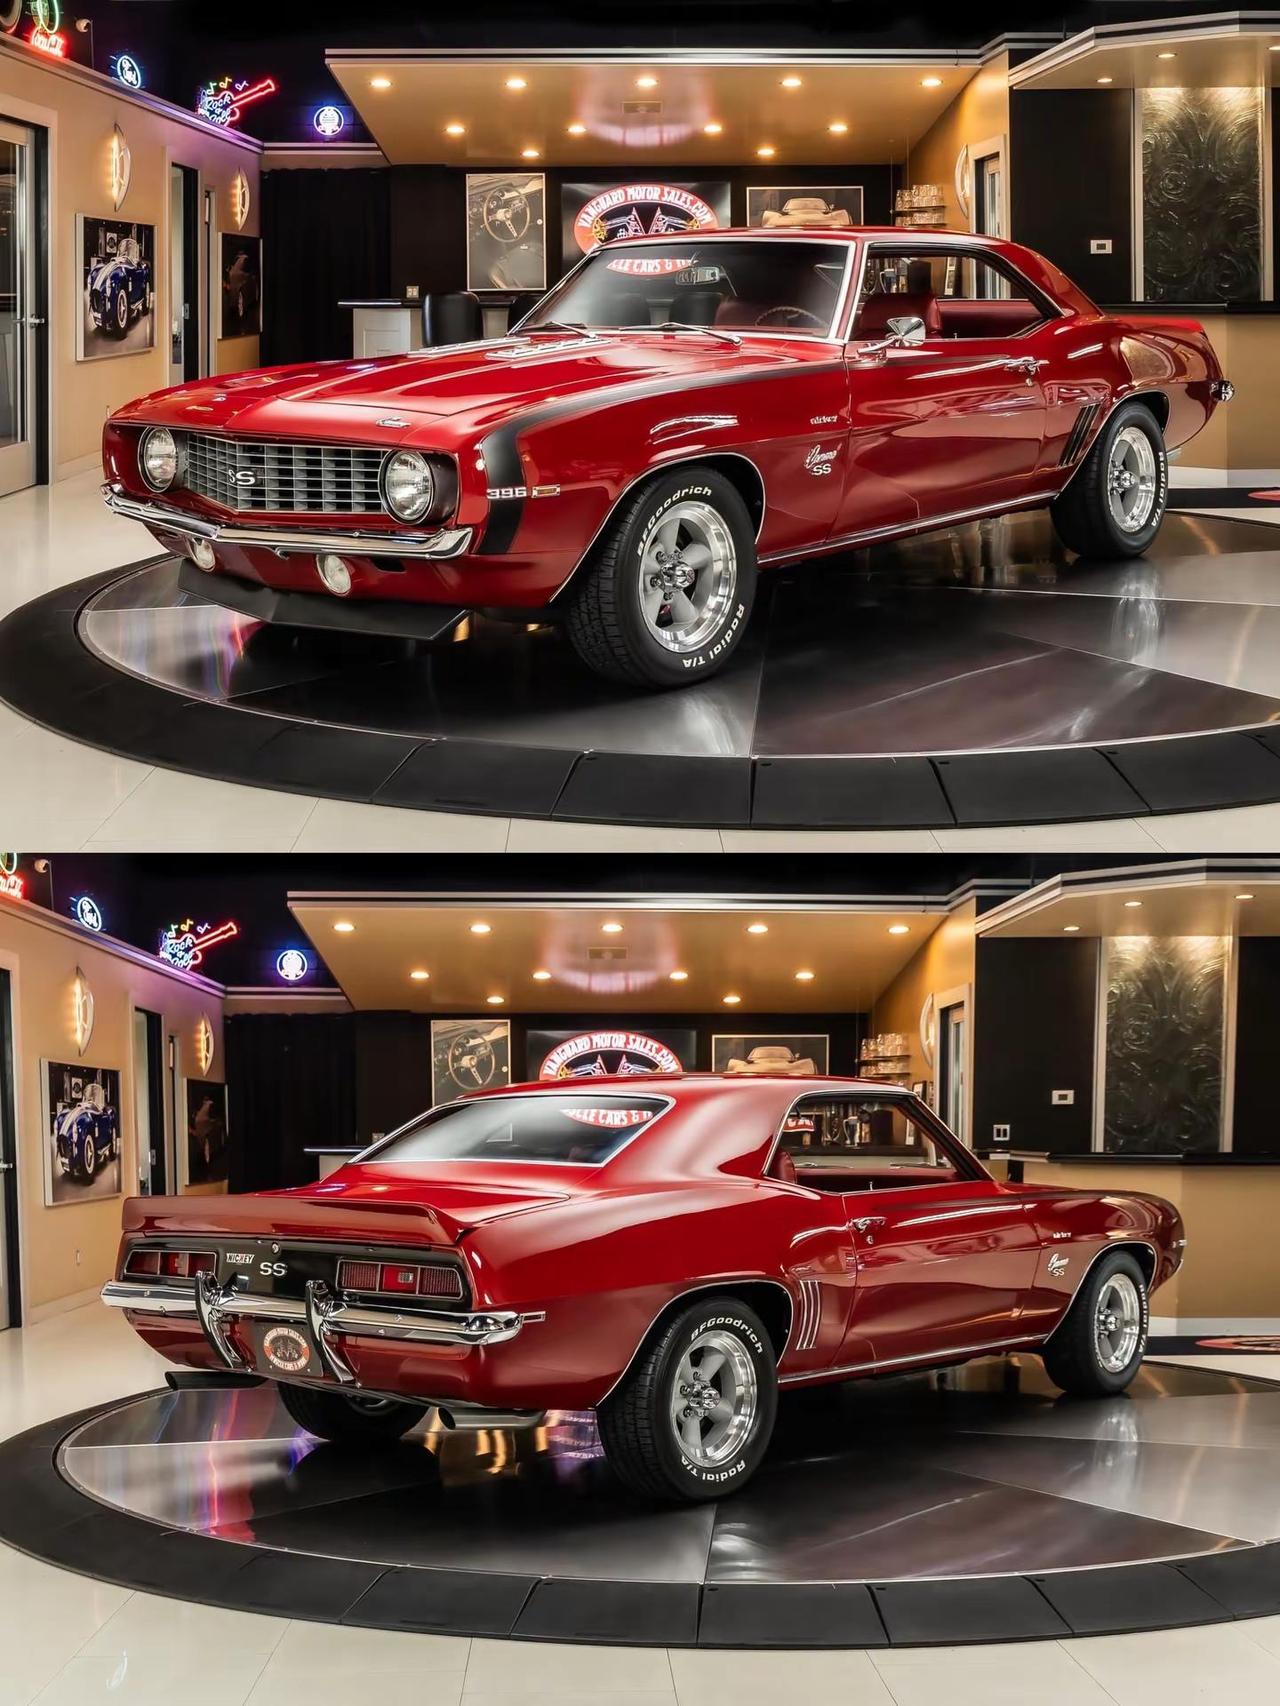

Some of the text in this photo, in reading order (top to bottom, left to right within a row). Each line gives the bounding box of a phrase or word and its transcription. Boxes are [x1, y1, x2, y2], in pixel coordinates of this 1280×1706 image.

[577, 186, 714, 228] VANGUARD MOTOR SALES.COM
[633, 259, 660, 273] CARS
[228, 469, 256, 486] SS
[811, 463, 832, 476] SS
[486, 486, 527, 500] 396
[637, 485, 712, 556] BFGoodrich
[682, 603, 744, 669] Radial T/A
[543, 1033, 678, 1076] VANGUARD MOTOR SALES.COM
[598, 1109, 628, 1126] CARS
[260, 1262, 287, 1276] SS
[690, 1317, 763, 1354] BFGoodrich
[681, 1454, 746, 1483] Radial T/A
